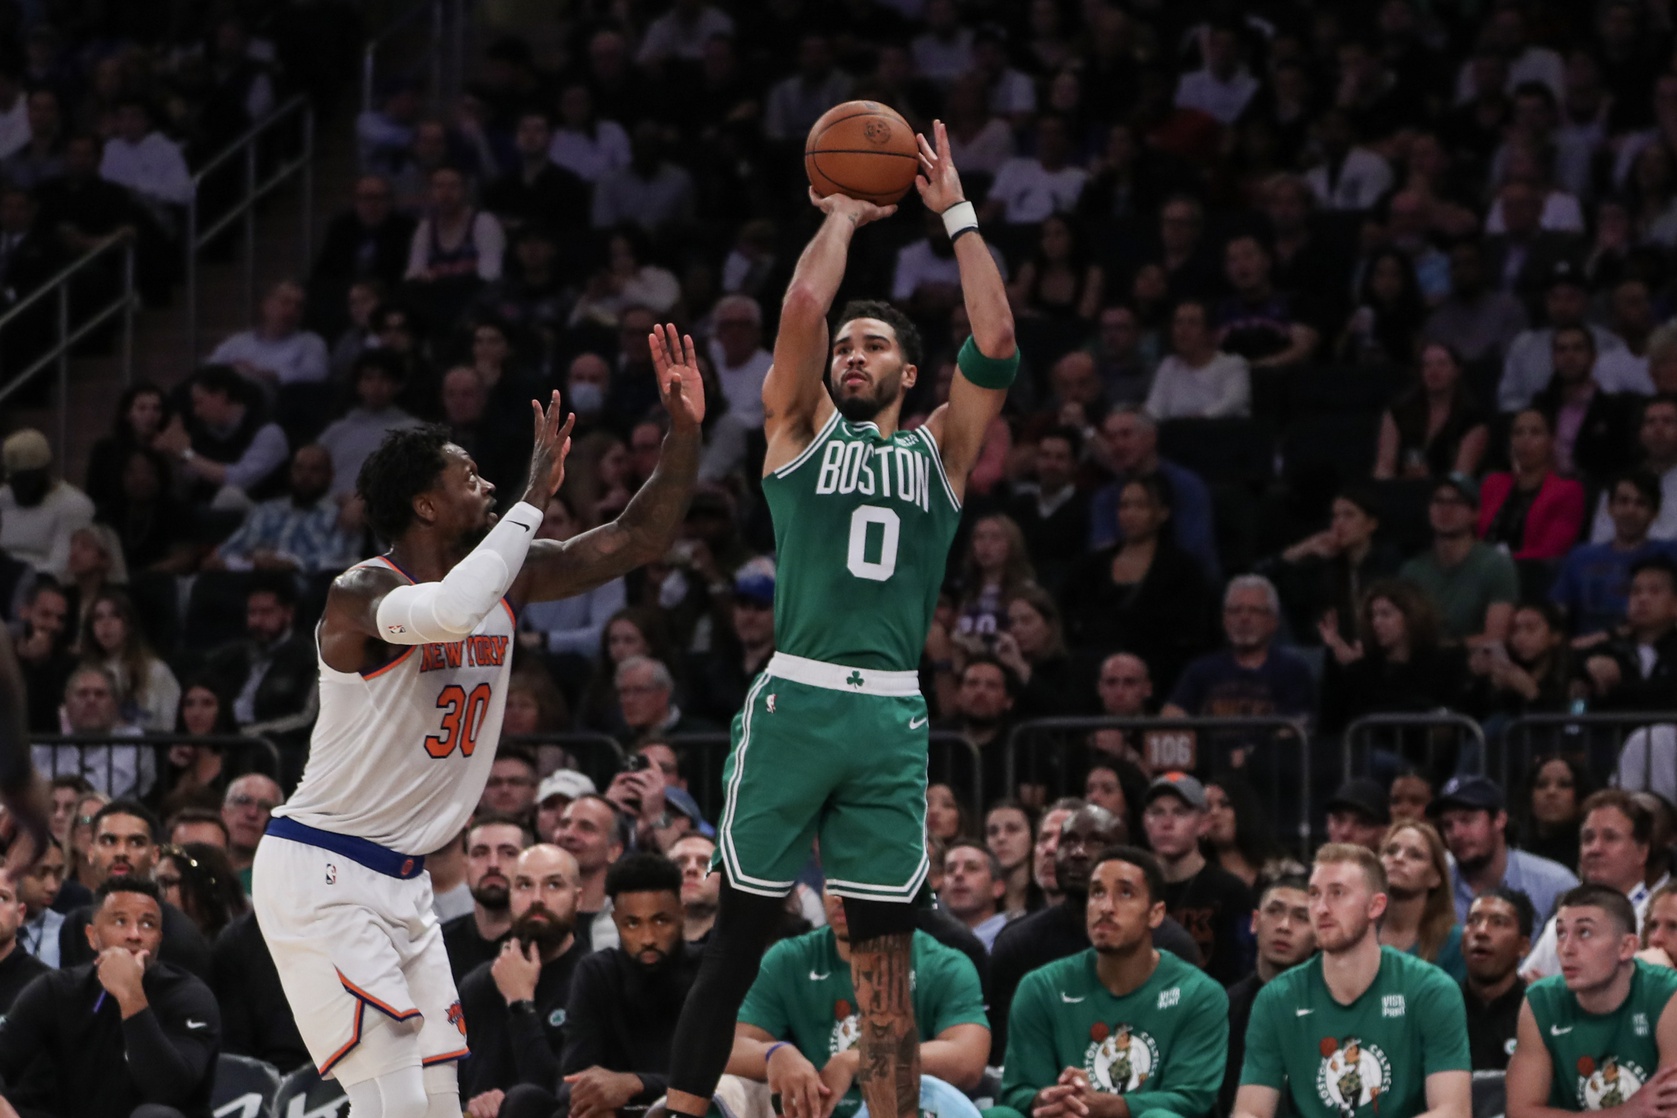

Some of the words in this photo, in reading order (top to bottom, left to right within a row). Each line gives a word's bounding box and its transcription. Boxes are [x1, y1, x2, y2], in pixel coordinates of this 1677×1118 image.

[815, 440, 930, 513] BOSTON
[847, 504, 901, 582] 0
[420, 641, 465, 673] NEW
[423, 682, 492, 759] 30
[1150, 734, 1192, 768] 106
[1368, 1043, 1392, 1093] CELTICS
